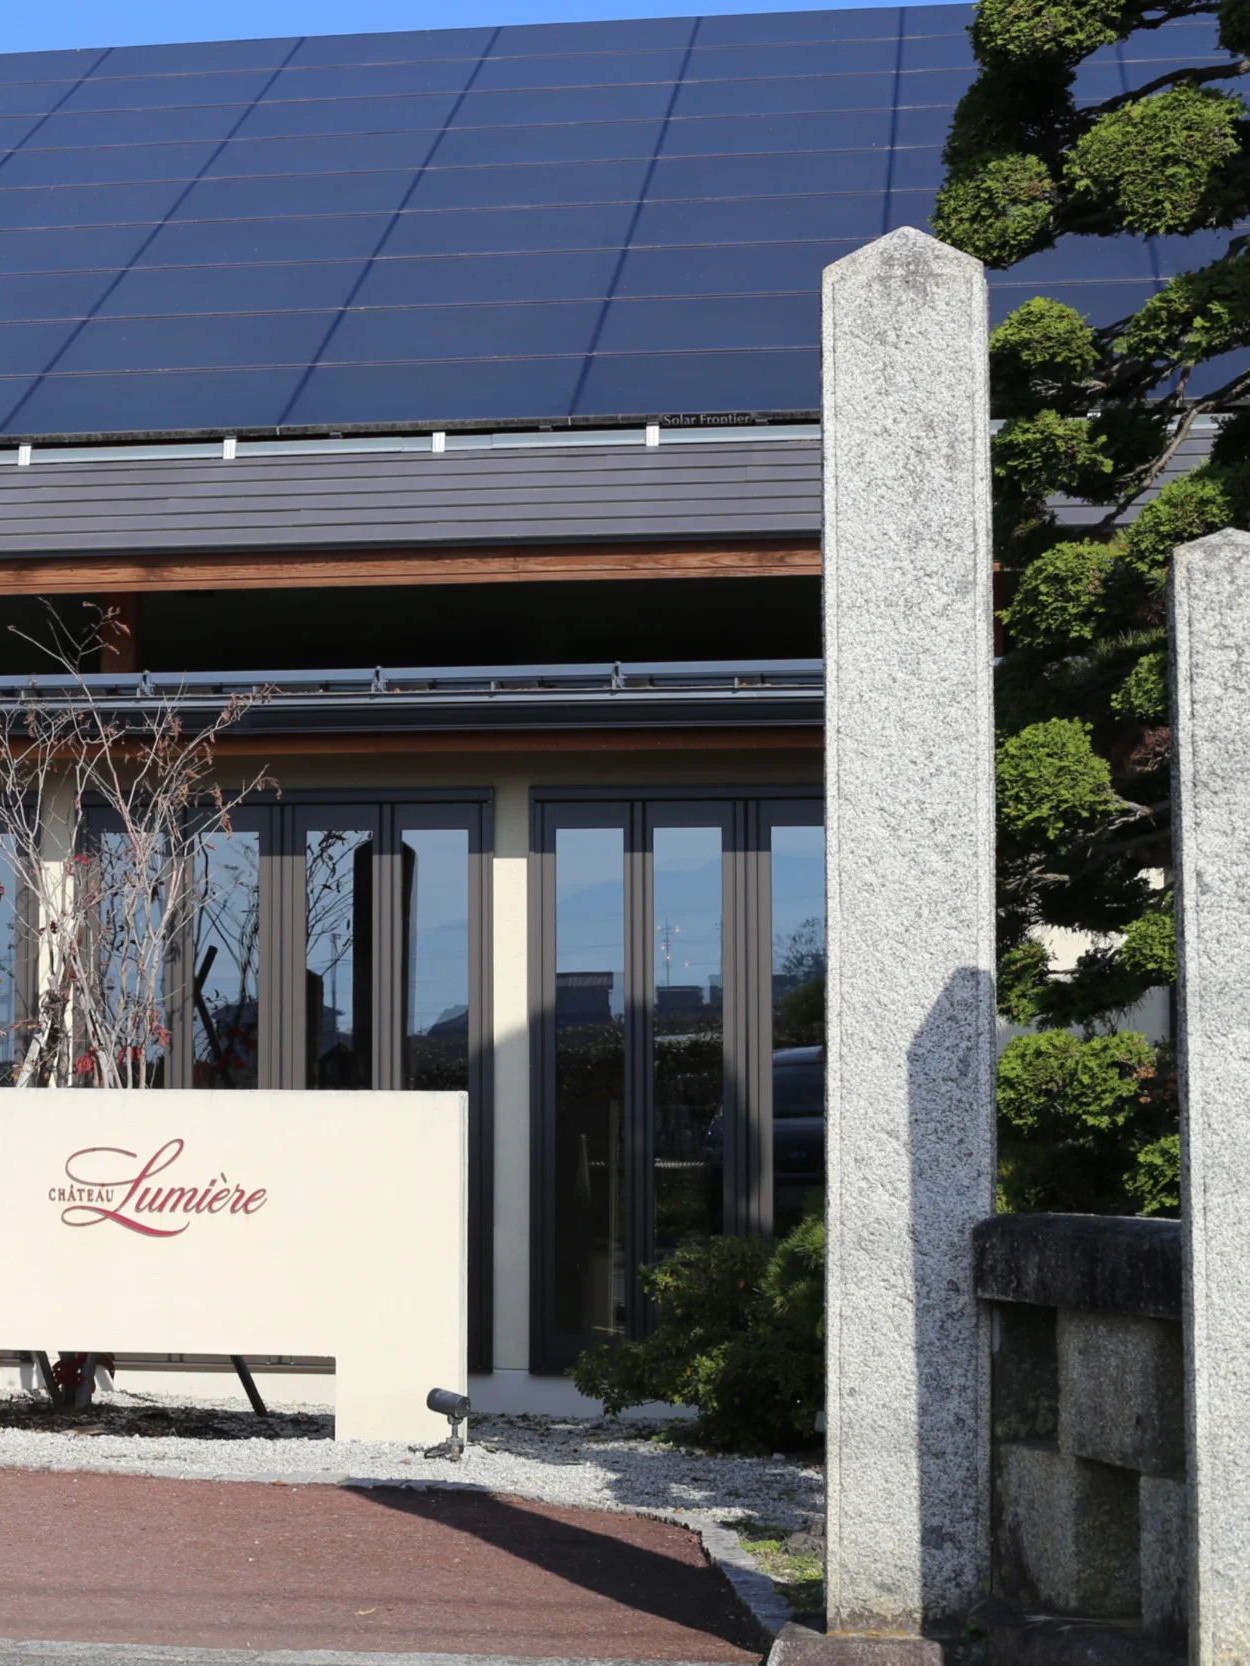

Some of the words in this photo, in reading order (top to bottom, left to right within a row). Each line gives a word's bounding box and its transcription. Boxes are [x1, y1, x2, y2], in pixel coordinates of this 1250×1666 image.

[663, 414, 696, 425] Solar
[699, 413, 750, 424] Frontier
[48, 1184, 115, 1202] CHÂTEAU
[61, 1138, 268, 1238] Lumière
